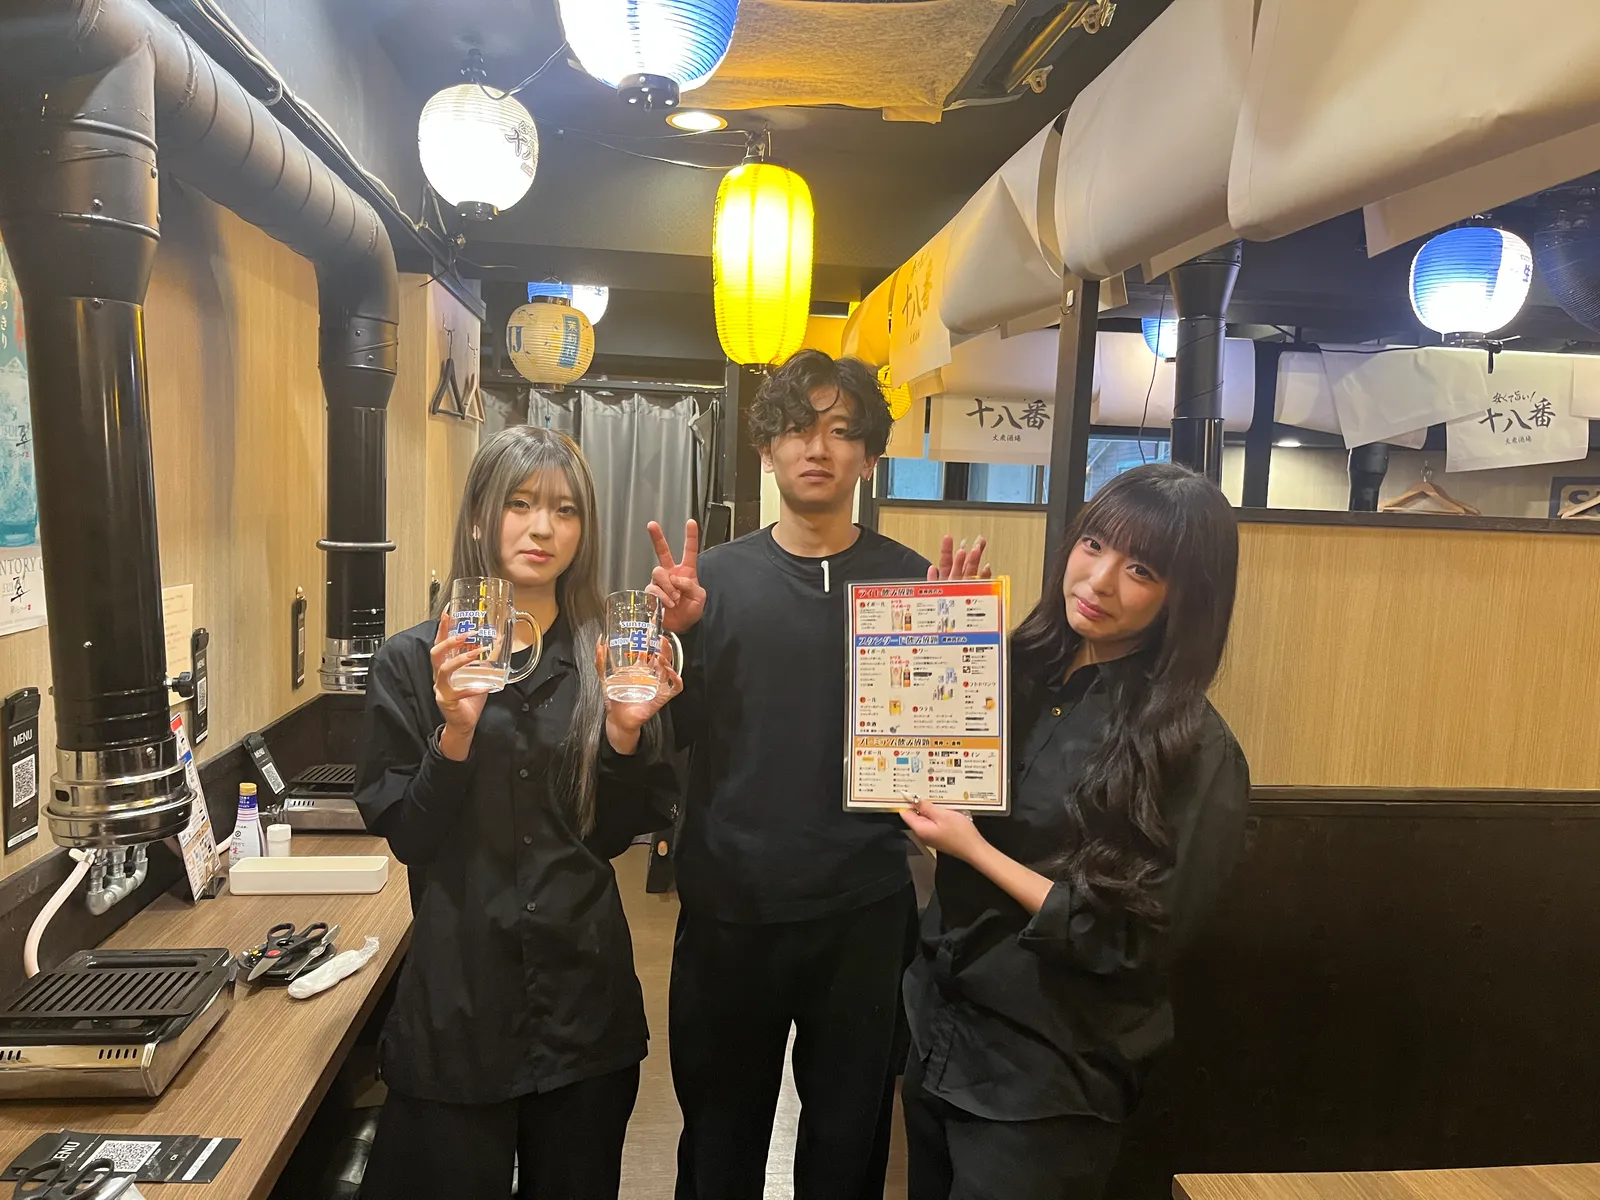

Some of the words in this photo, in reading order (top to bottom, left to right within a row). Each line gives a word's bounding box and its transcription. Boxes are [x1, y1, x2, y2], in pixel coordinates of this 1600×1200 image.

[966, 398, 1050, 430] 十八番
[1478, 398, 1556, 433] 十八番
[453, 611, 487, 619] SUNTORY
[629, 630, 648, 651] 生
[13, 728, 33, 747] MENU
[52, 1141, 80, 1162] ENU
